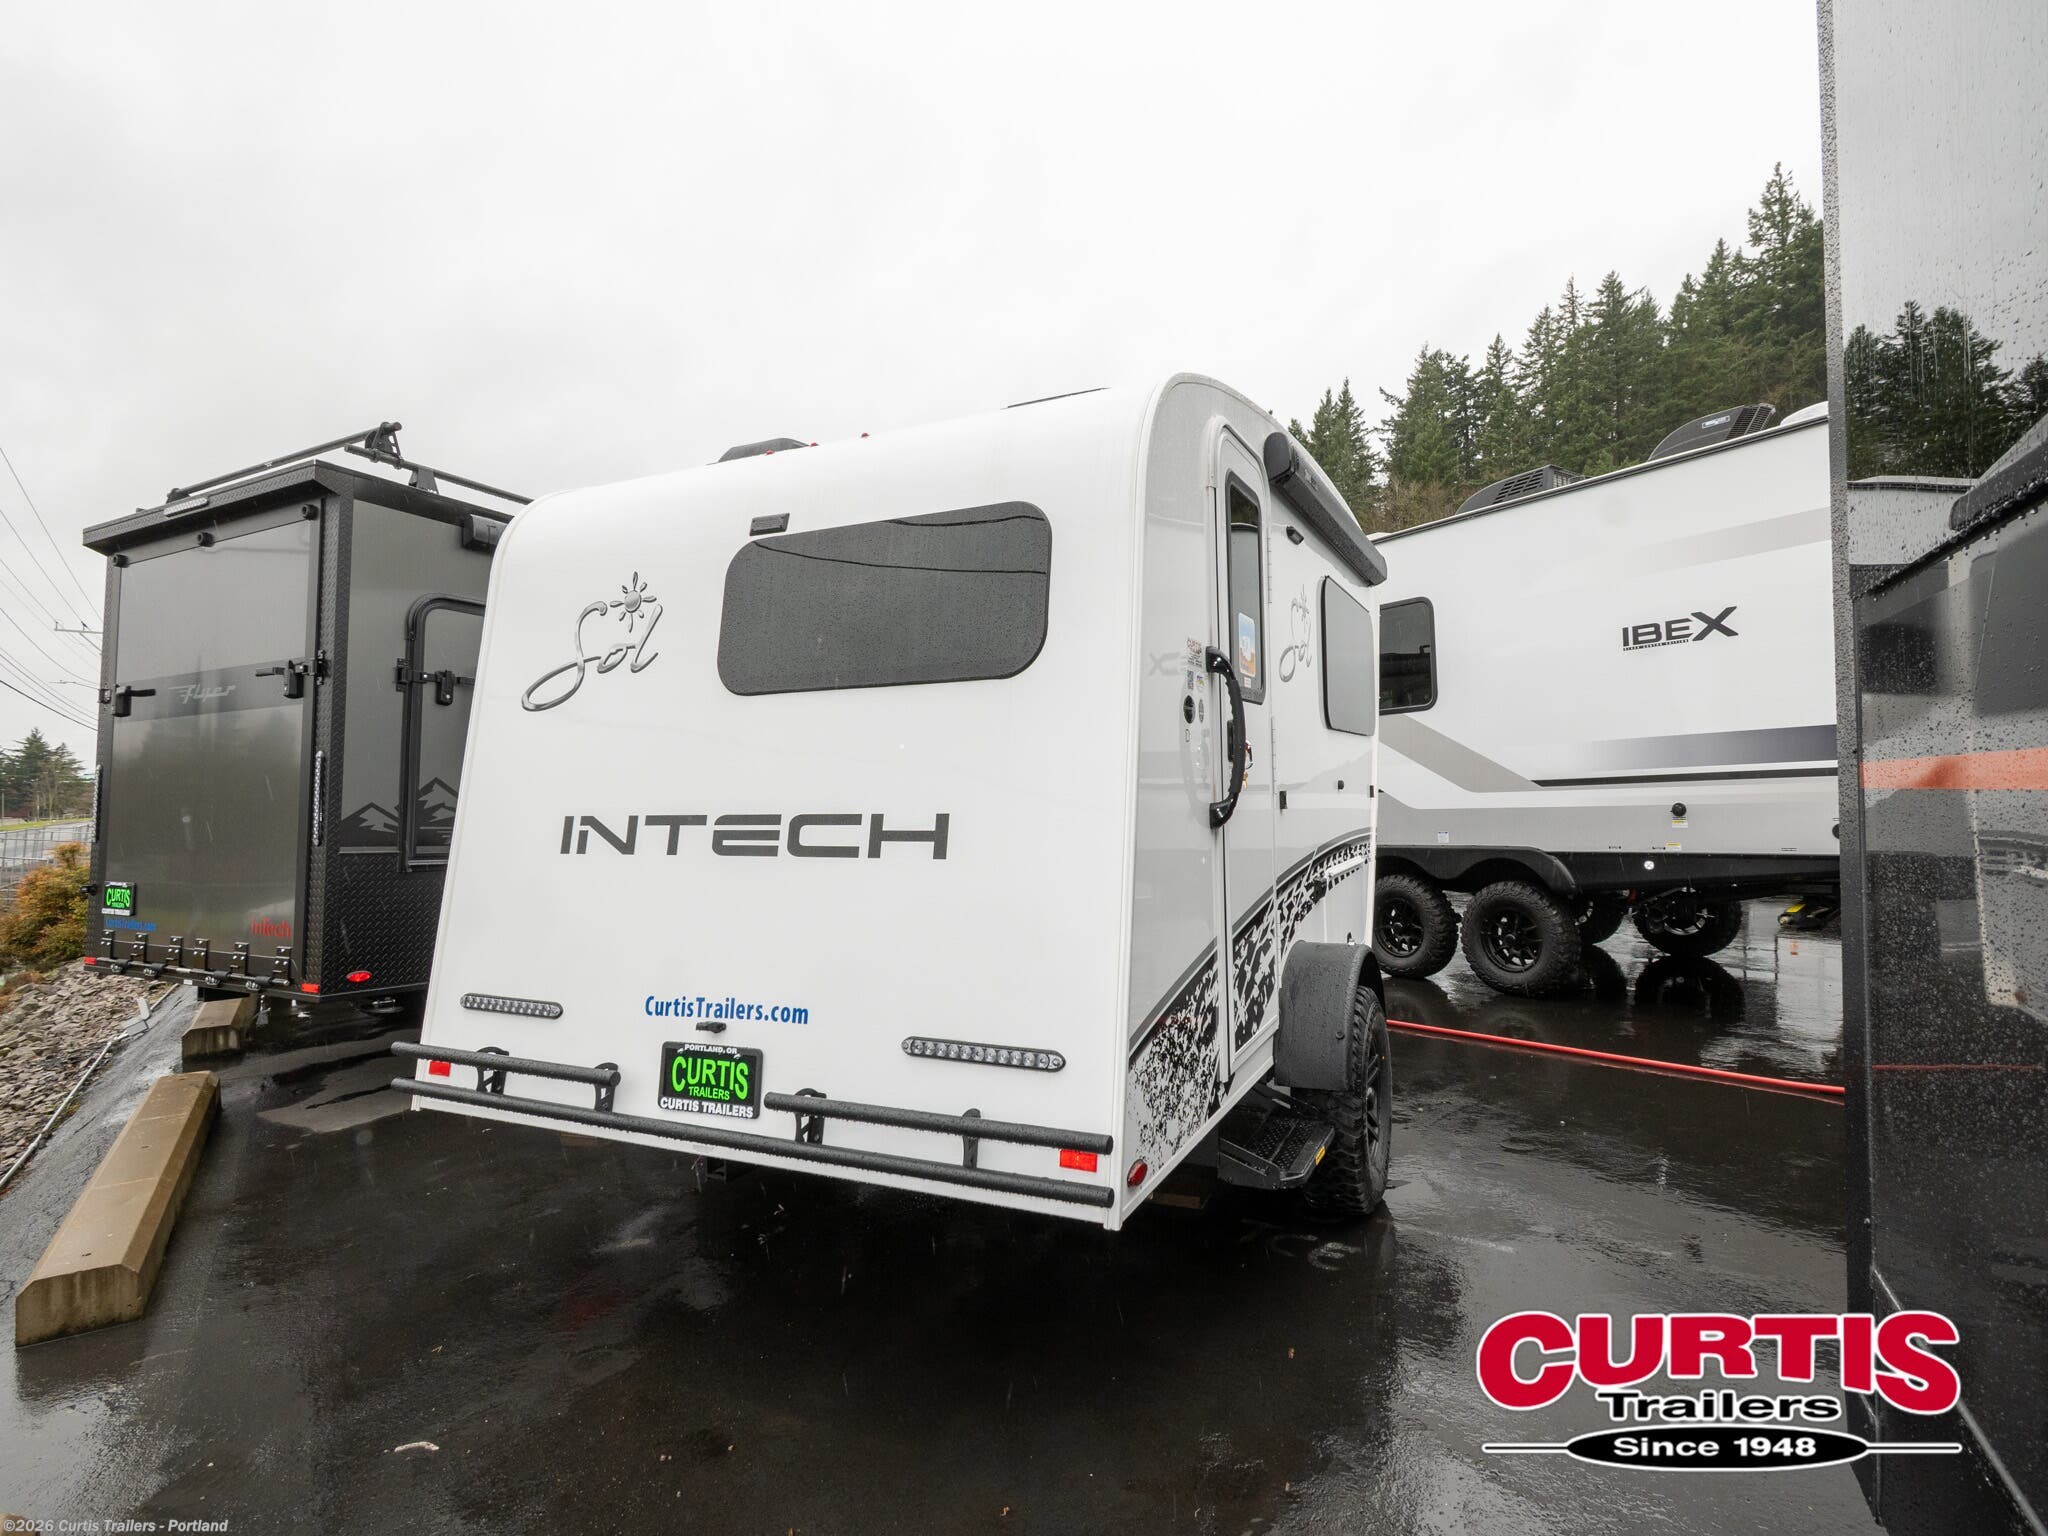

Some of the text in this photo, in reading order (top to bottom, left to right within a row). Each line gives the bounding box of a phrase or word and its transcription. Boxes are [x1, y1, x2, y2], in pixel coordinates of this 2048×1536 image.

[1622, 606, 1739, 647] IBEX
[521, 600, 664, 712] Sol
[560, 813, 950, 860] INTECH
[106, 888, 131, 907] CURTIS
[645, 995, 809, 1025] CurtisTrailers.com
[726, 1047, 738, 1055] OR
[672, 1056, 749, 1100] CURTIS
[660, 1097, 754, 1118] CURTIS TRAILERS
[688, 1086, 730, 1101] TRAILERS
